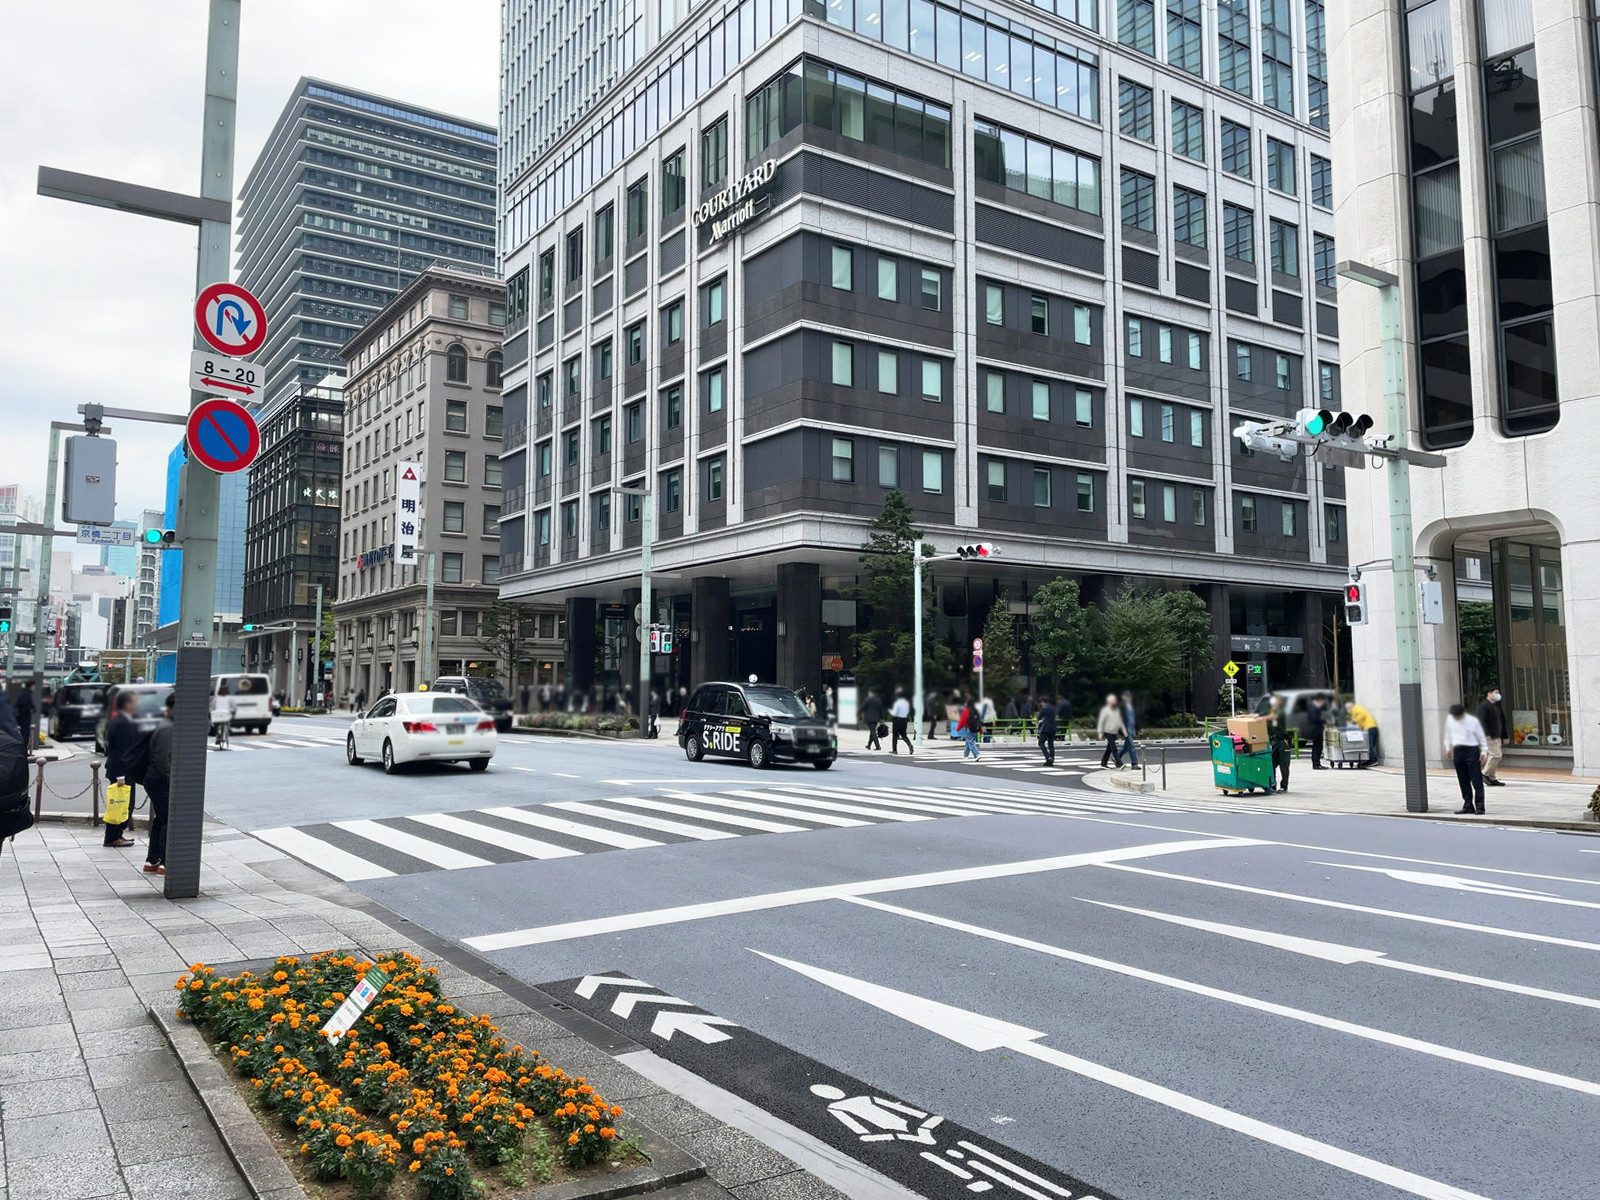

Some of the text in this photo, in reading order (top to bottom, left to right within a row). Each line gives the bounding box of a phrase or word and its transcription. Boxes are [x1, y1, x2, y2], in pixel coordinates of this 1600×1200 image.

[691, 158, 775, 228] COURTYARD
[709, 199, 755, 245] Marriott
[80, 529, 132, 541] 京橋二丁目
[400, 498, 416, 559] 明治屋
[702, 730, 741, 753] S.RIDE
